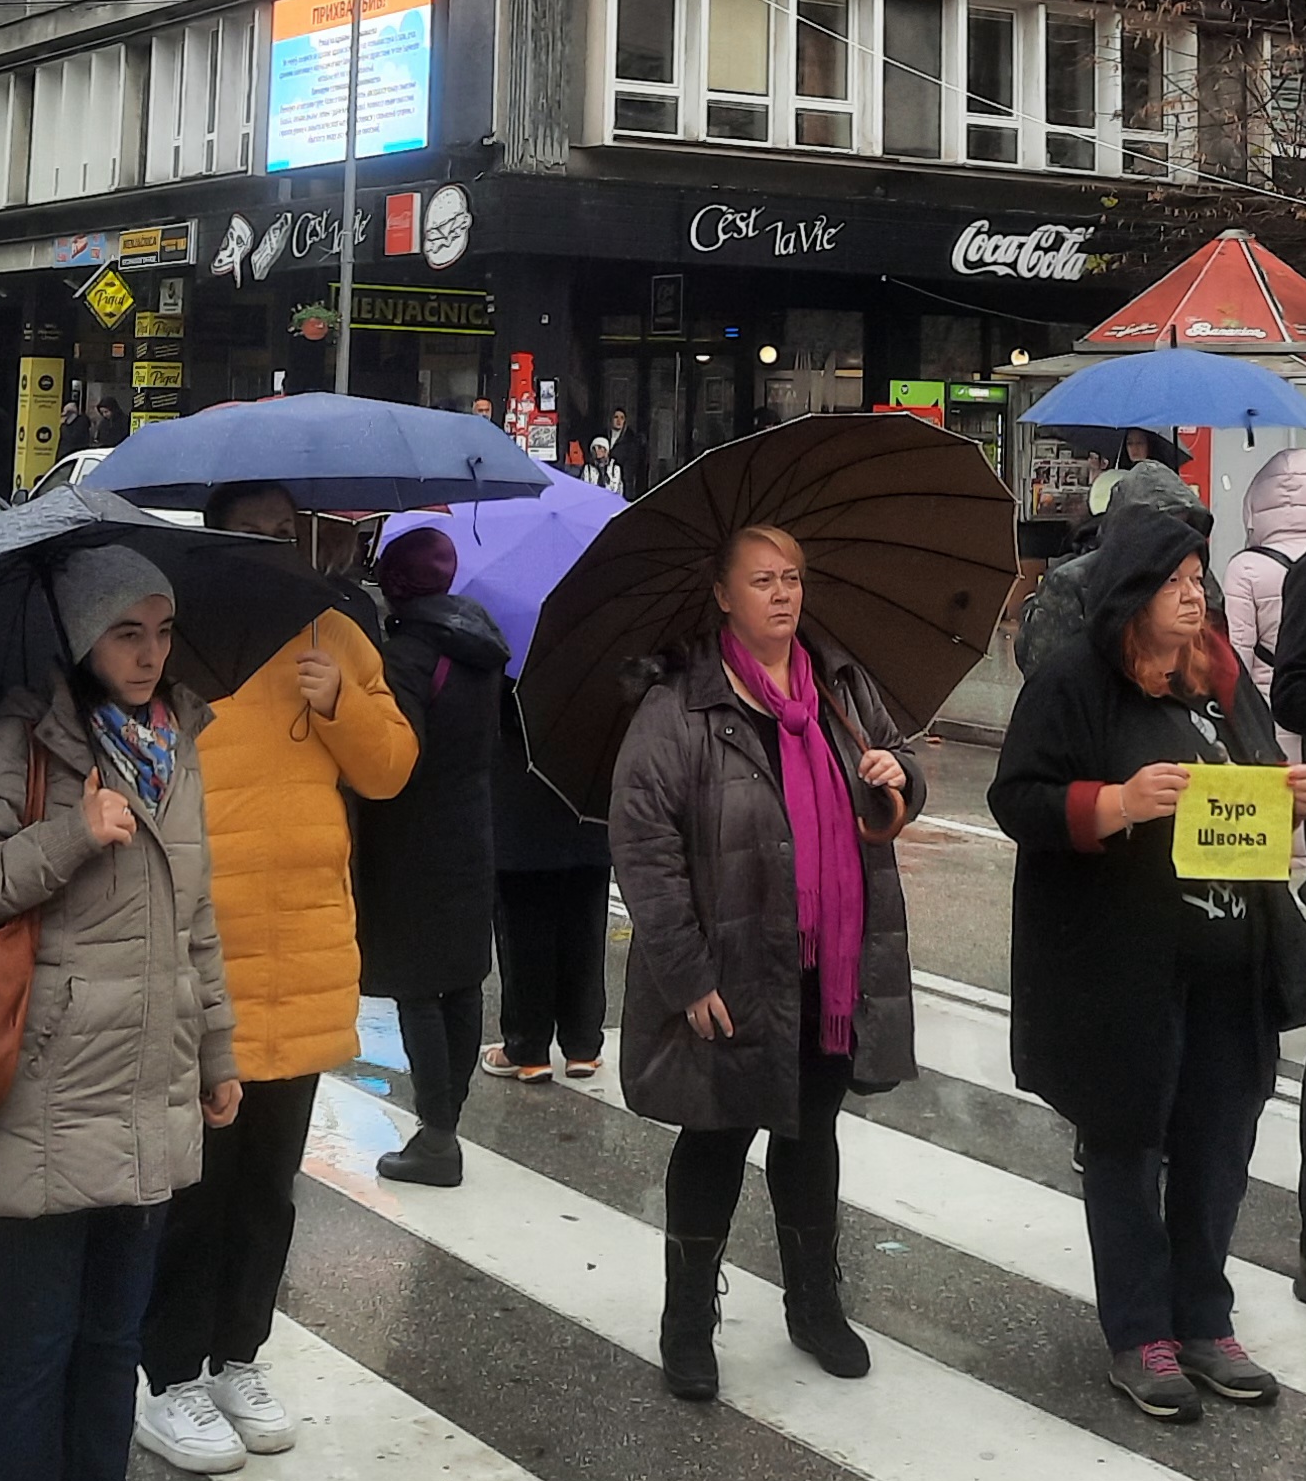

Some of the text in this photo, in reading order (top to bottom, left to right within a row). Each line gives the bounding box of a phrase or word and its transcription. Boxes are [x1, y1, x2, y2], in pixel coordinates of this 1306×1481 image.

[797, 215, 845, 253] Vie
[351, 294, 491, 324] ENJAČNIC
[1207, 798, 1257, 821] Ђуро
[1197, 828, 1267, 846] Швоња
